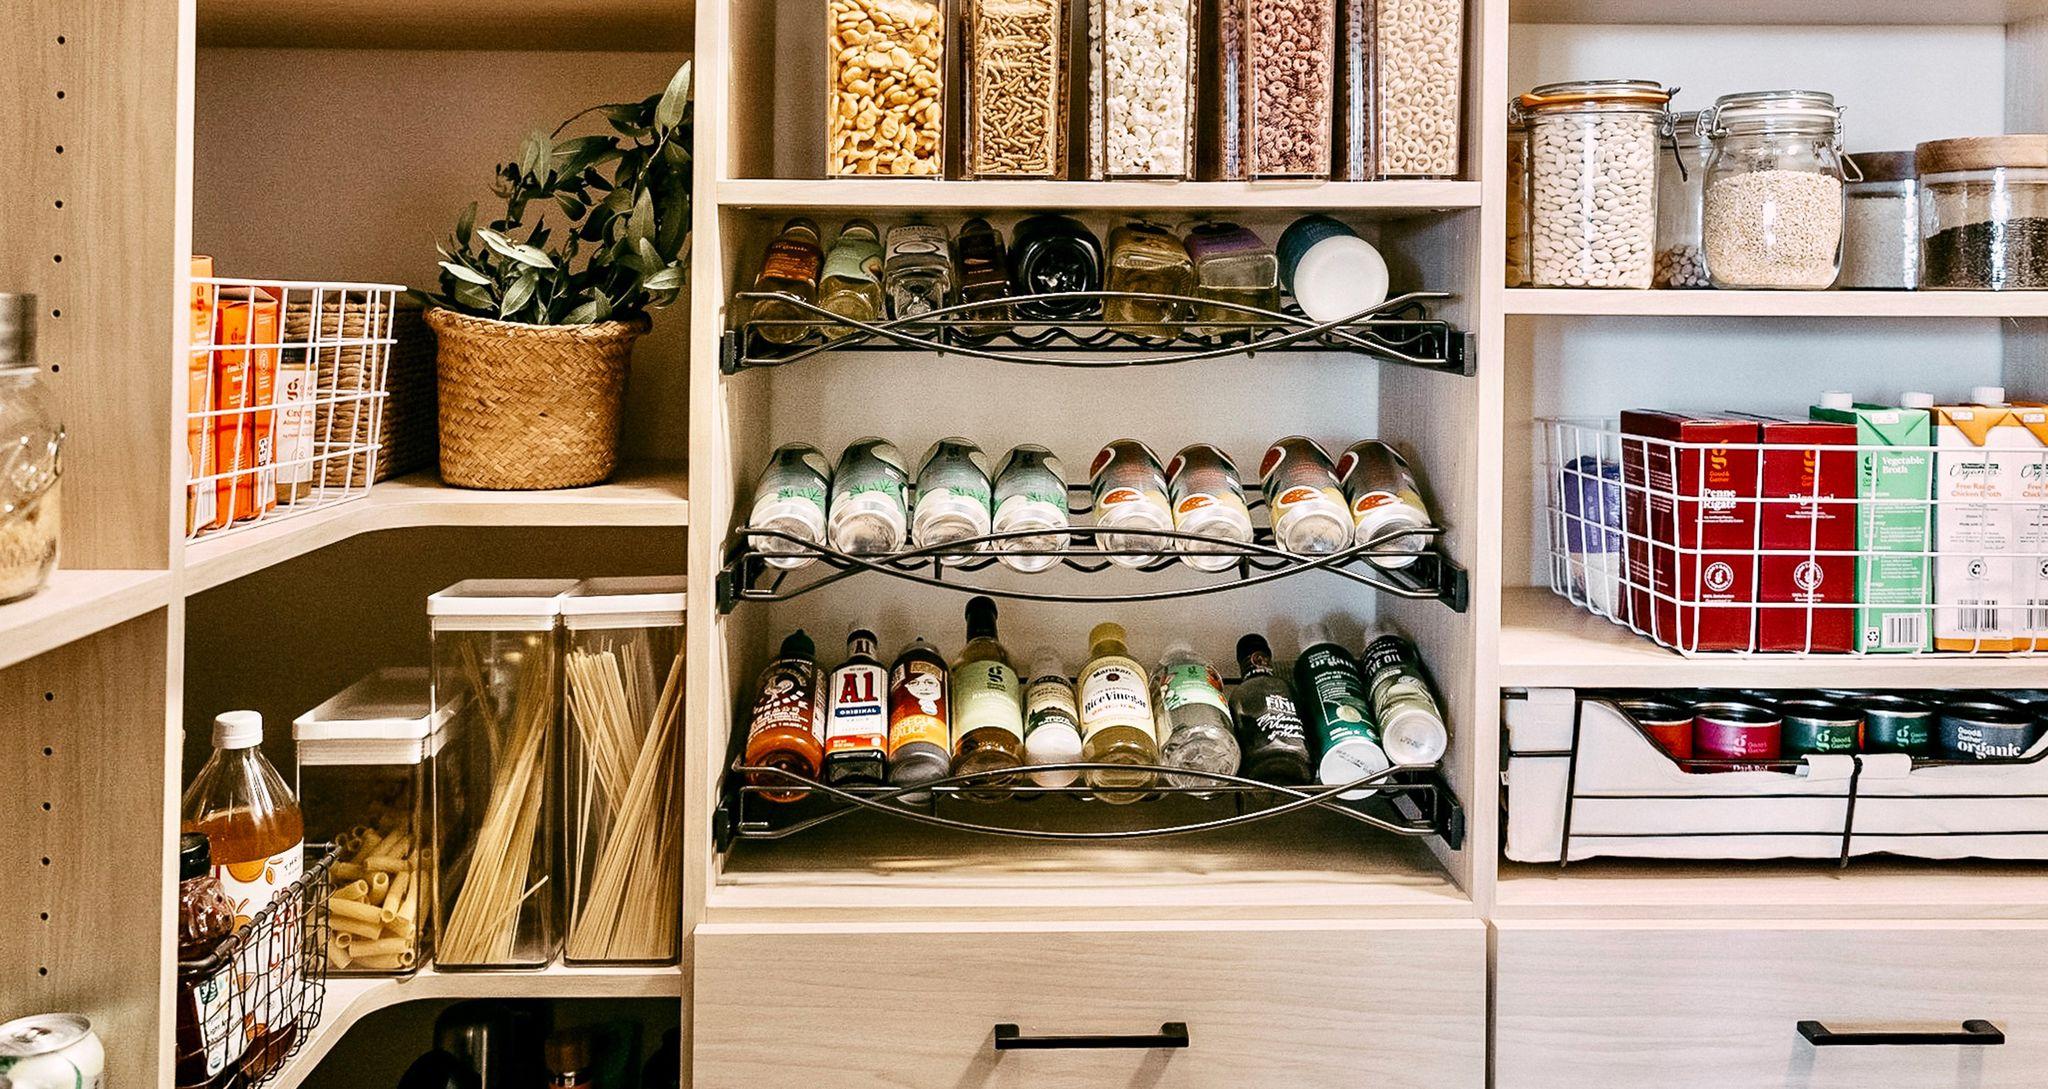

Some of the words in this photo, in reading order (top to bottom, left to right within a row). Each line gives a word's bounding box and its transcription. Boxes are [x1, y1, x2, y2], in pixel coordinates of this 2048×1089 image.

[1882, 456, 1925, 467] Vegetable
[1882, 465, 1908, 474] Broth
[1704, 488, 1737, 498] Penne
[1788, 493, 1835, 506] Rigaoni
[1383, 654, 1402, 664] OIL
[1084, 696, 1106, 715] Rice
[1105, 691, 1147, 709] Vinegar
[1265, 695, 1296, 713] FINI
[1957, 741, 2021, 760] organic
[1733, 764, 1753, 772] Dark
